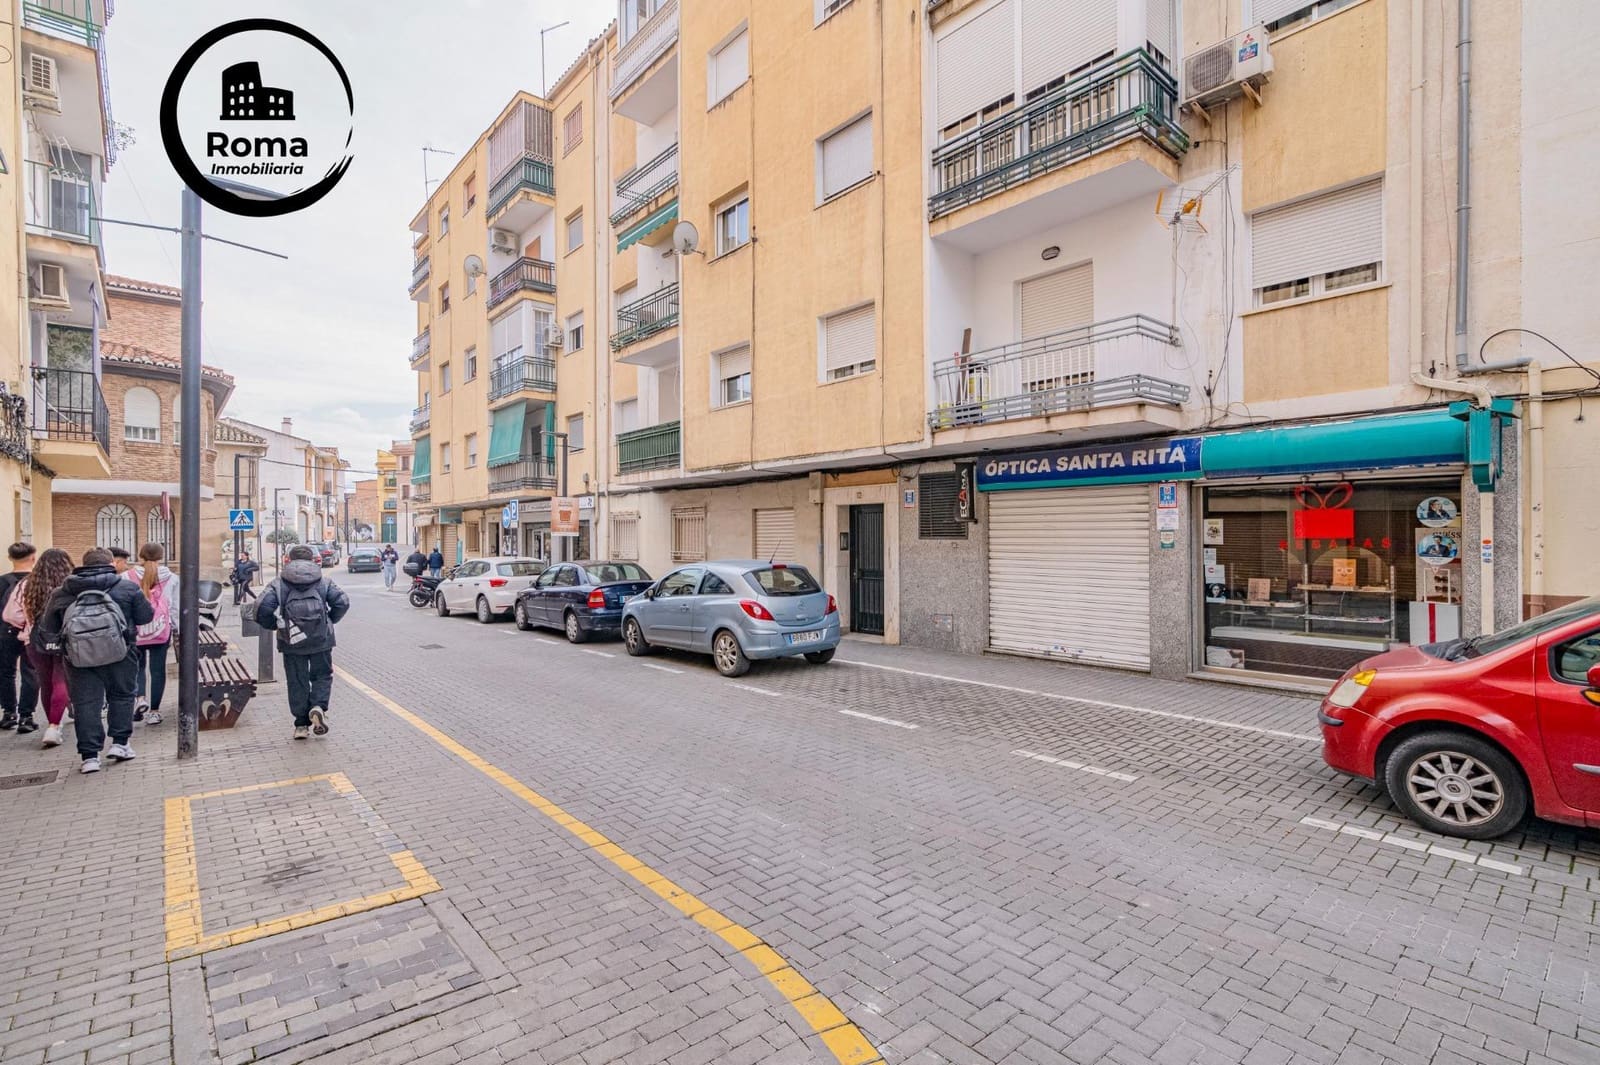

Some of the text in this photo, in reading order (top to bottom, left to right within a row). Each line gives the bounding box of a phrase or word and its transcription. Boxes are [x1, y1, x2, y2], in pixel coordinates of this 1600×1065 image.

[985, 447, 1187, 477] ÓPTICA SANTA RITA
[139, 615, 165, 636] NIKE
